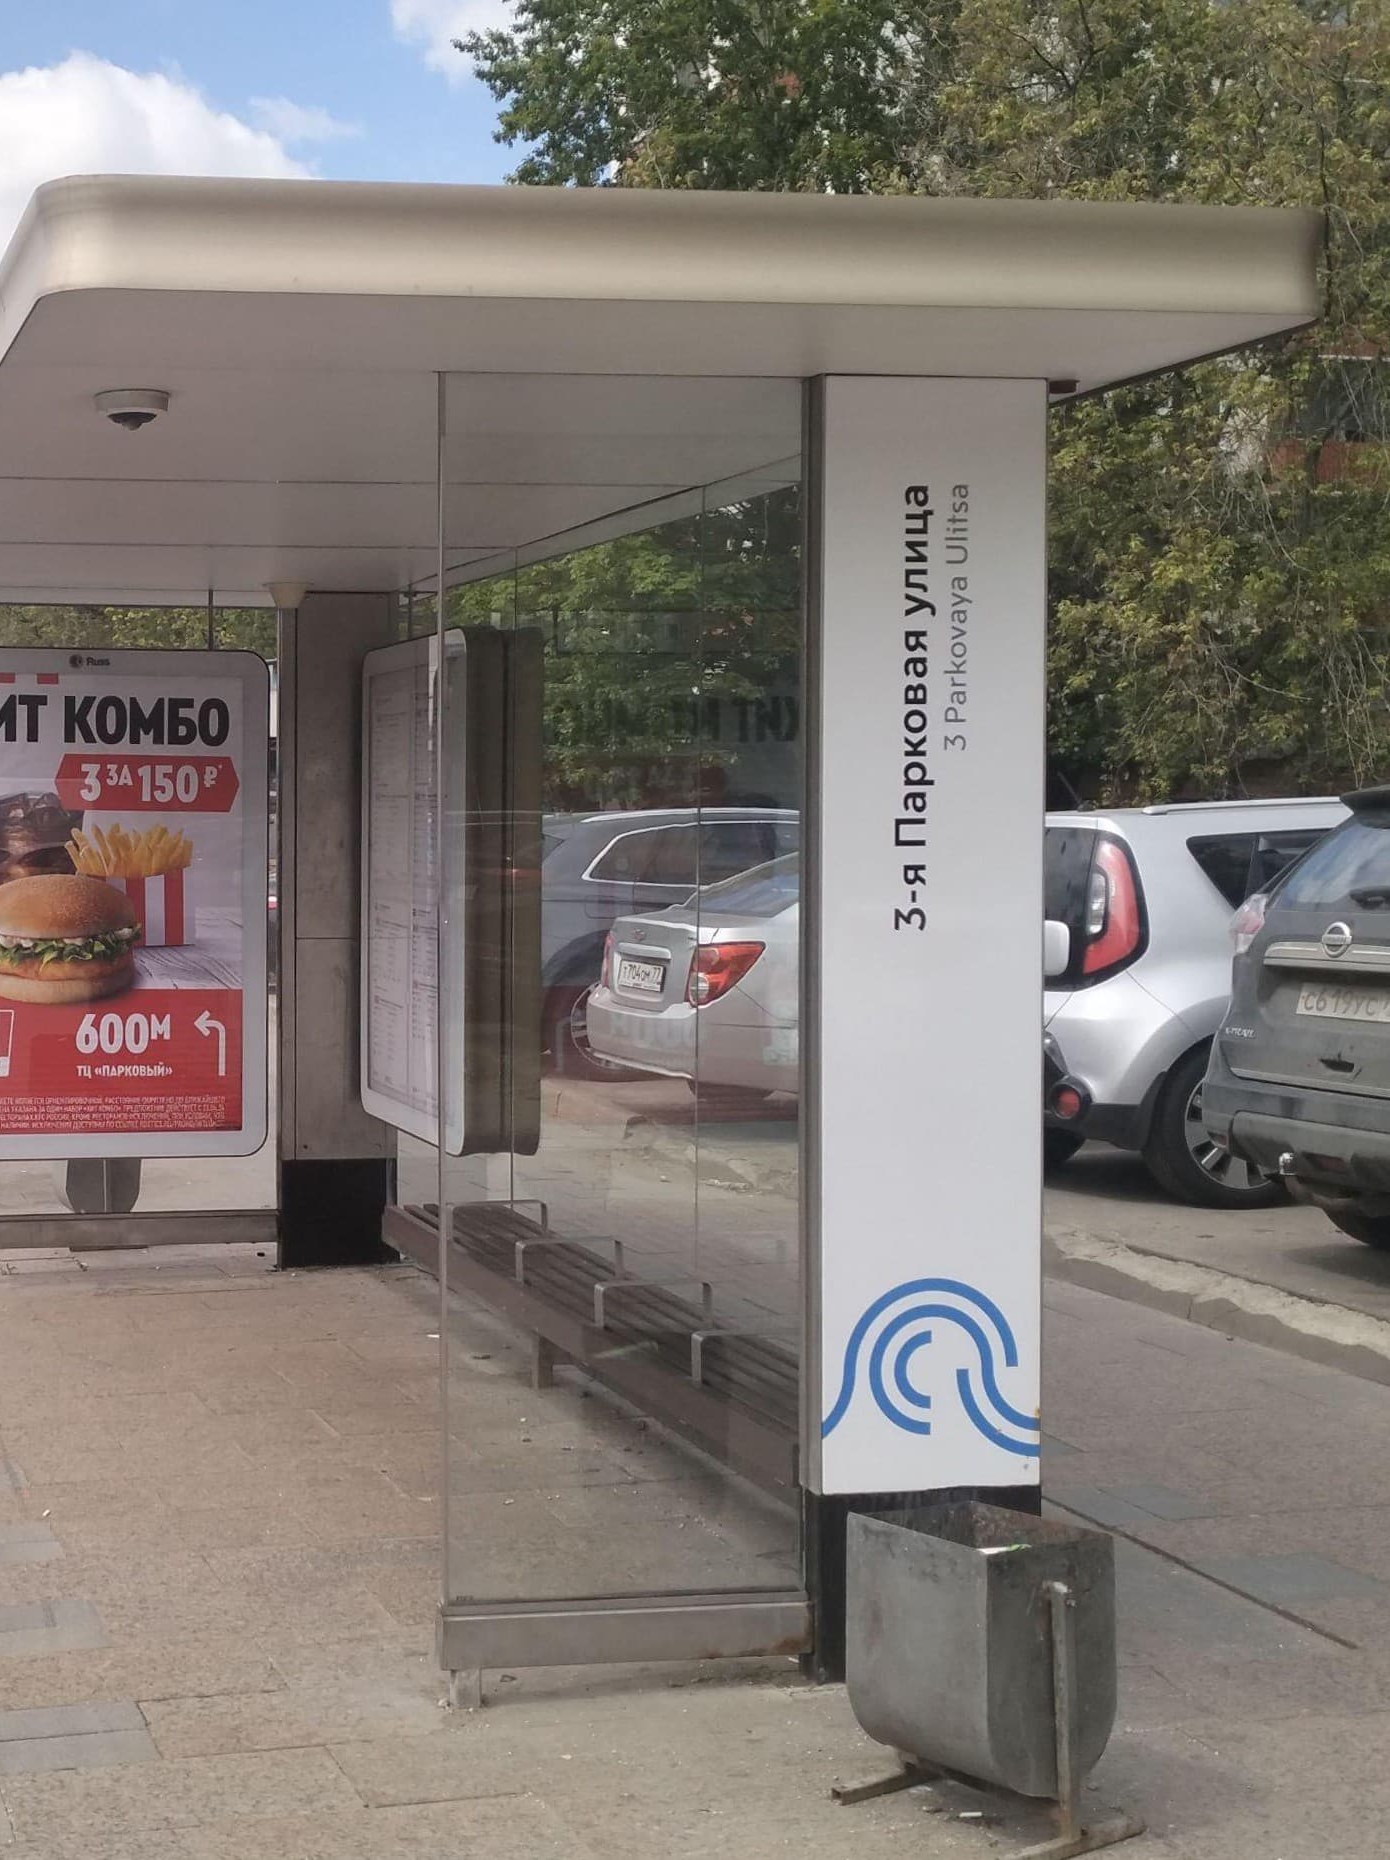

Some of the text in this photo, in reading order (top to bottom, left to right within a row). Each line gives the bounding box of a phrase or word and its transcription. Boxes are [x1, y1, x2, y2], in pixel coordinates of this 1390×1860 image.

[943, 484, 973, 751] 3 Parkovaya Ulitsa
[63, 695, 230, 747] КОМБО
[894, 485, 937, 931] 3-я Парковая улица
[80, 763, 101, 802] 3
[106, 764, 133, 786] ЗА
[138, 765, 199, 803] 150
[76, 1062, 173, 1079] ТЦ «ПАРКОВЫЙ»
